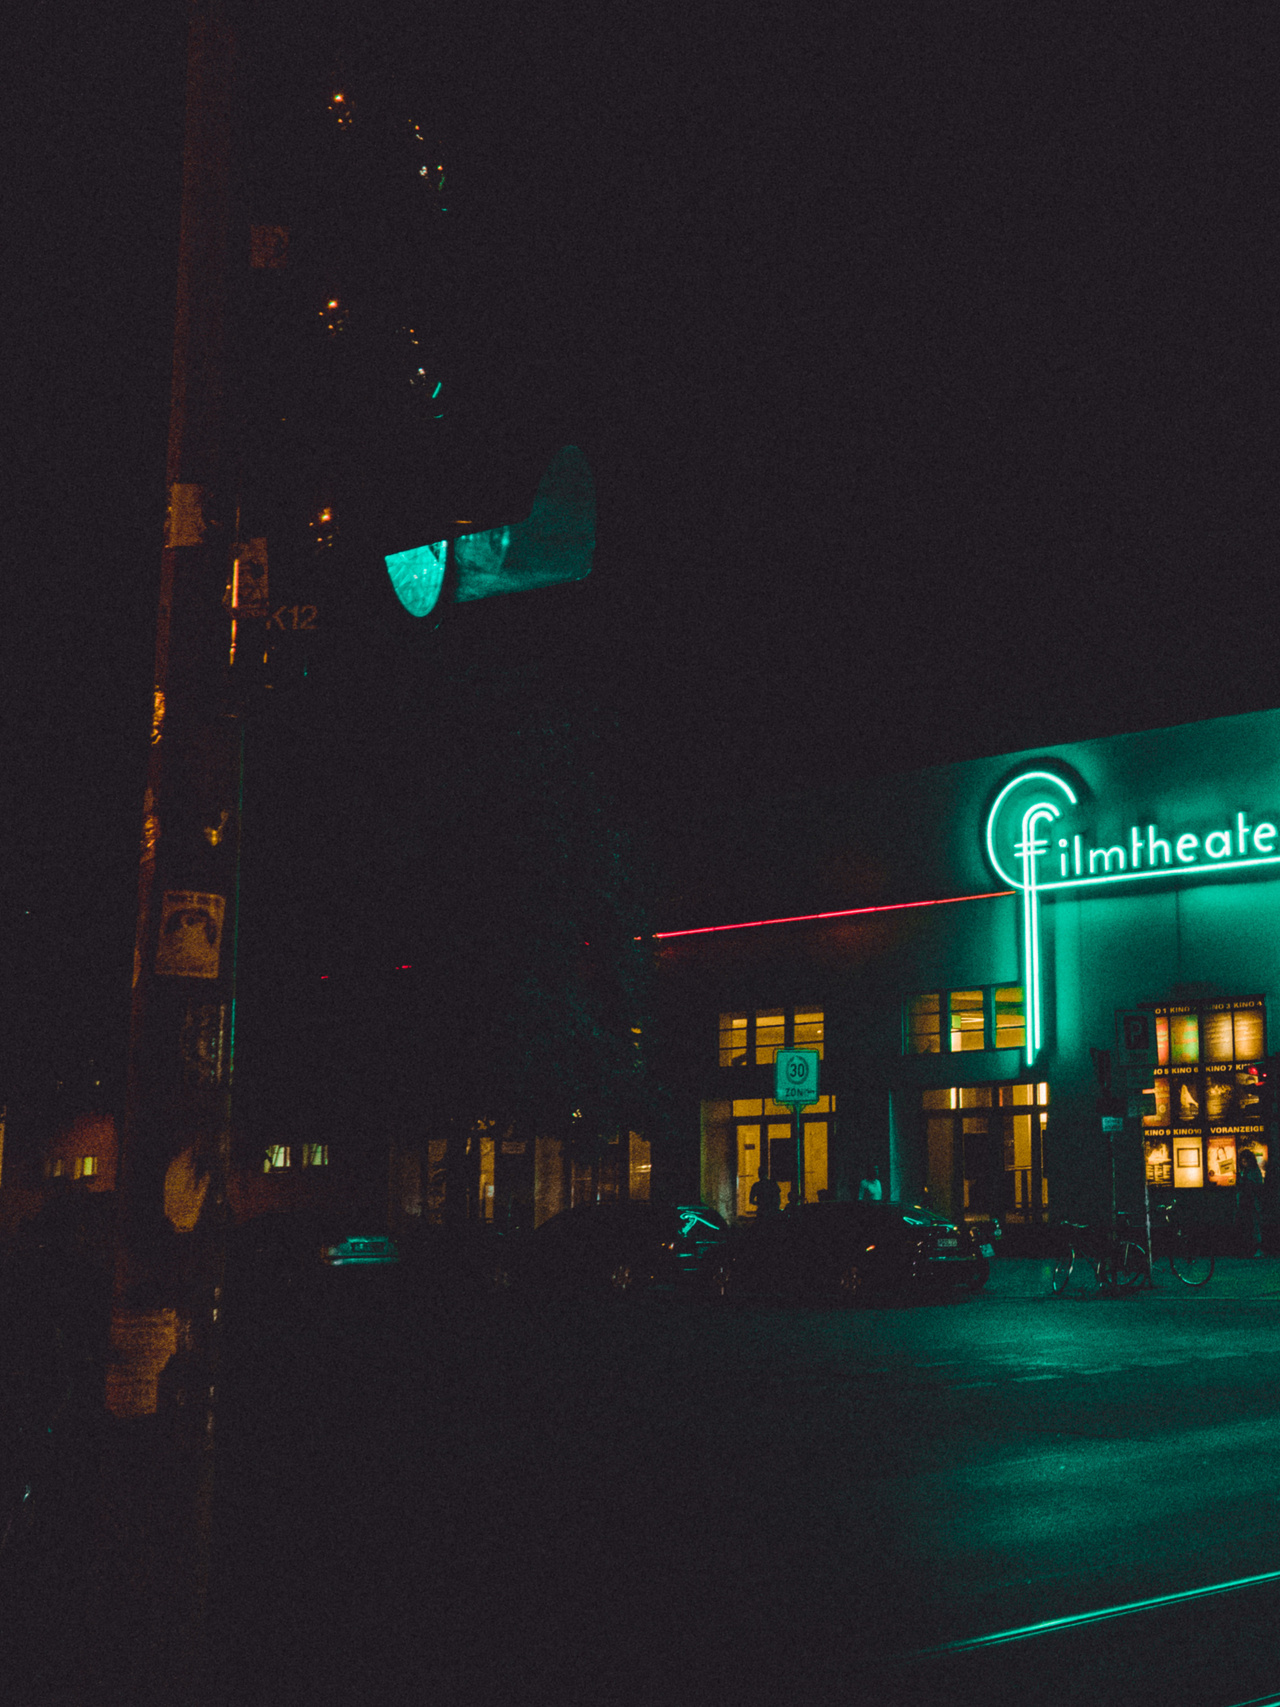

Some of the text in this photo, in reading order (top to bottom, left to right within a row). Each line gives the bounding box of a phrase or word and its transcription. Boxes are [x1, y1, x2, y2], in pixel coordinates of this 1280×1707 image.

[1233, 1001, 1255, 1009] KINO
[1130, 1021, 1142, 1044] P
[790, 1063, 805, 1077] 30
[1171, 1066, 1192, 1074] KINO
[1205, 1064, 1233, 1073] KINO 7
[785, 1087, 814, 1097] ZON
[1144, 1129, 1165, 1137] KINO
[1210, 1125, 1264, 1134] VORANZEIGE
